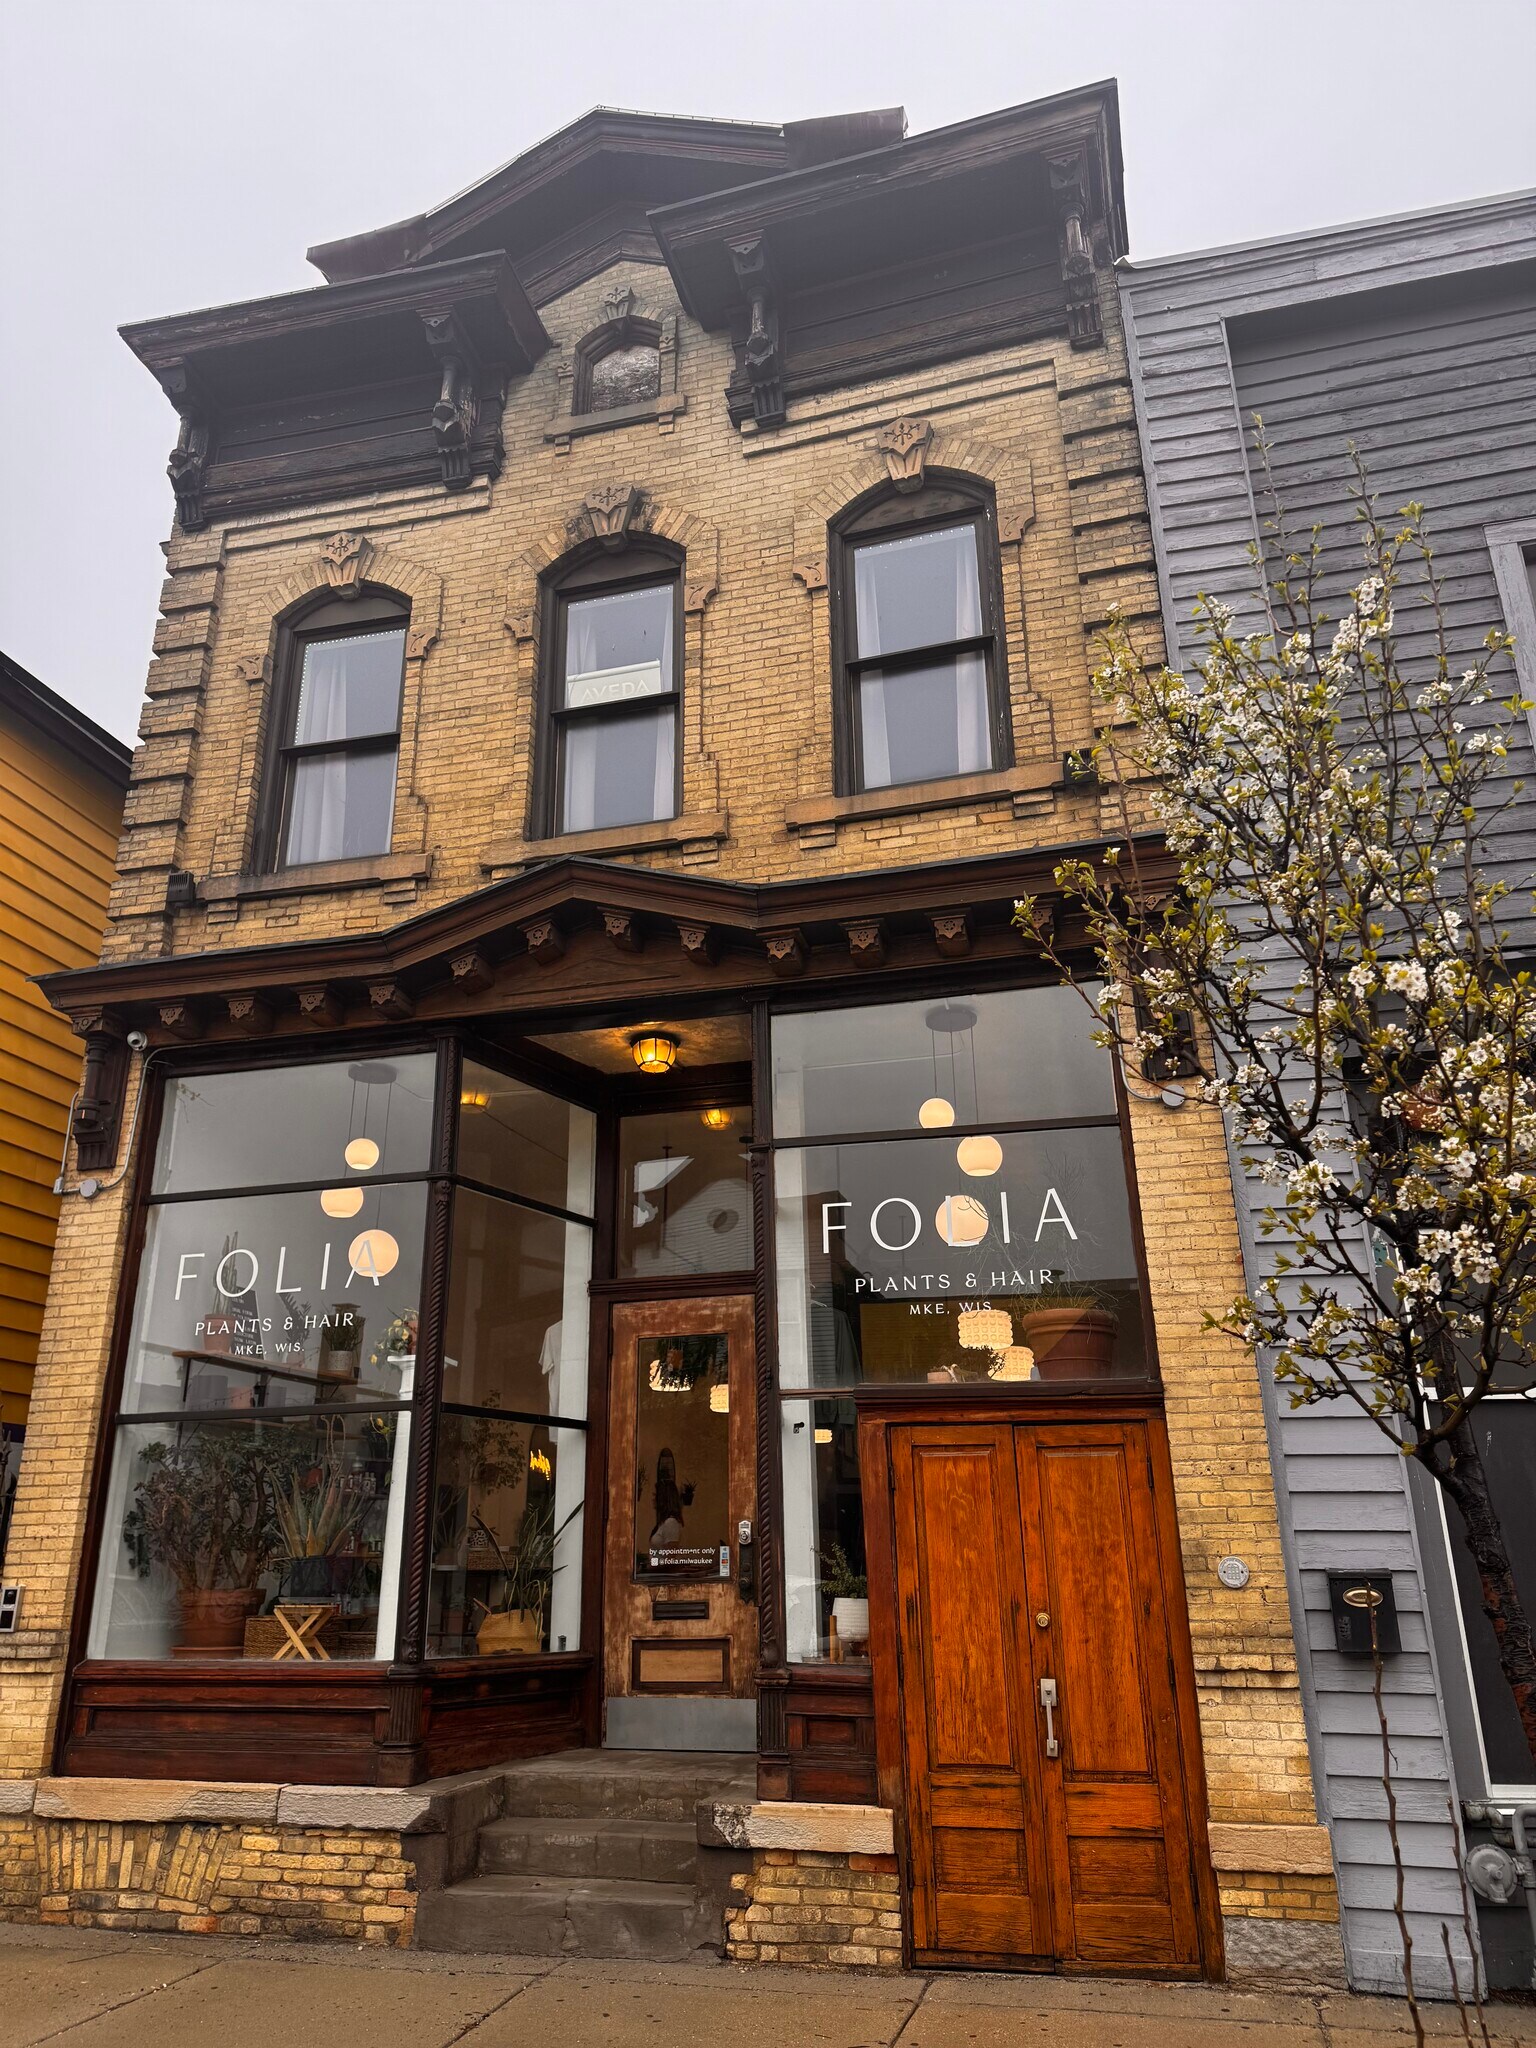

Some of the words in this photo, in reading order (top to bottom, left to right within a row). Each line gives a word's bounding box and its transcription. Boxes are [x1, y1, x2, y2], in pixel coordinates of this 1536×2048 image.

[581, 679, 651, 703] AVEDA
[822, 1187, 1078, 1254] FOLIA
[174, 1239, 380, 1301] FOLIA
[855, 1273, 951, 1293] PLANTS
[965, 1272, 977, 1288] &
[991, 1269, 1054, 1287] HAIR
[194, 1318, 272, 1336] PLANTS
[284, 1316, 293, 1331] &
[304, 1312, 354, 1330] HAIR
[649, 1548, 657, 1556] by
[701, 1547, 715, 1555] only
